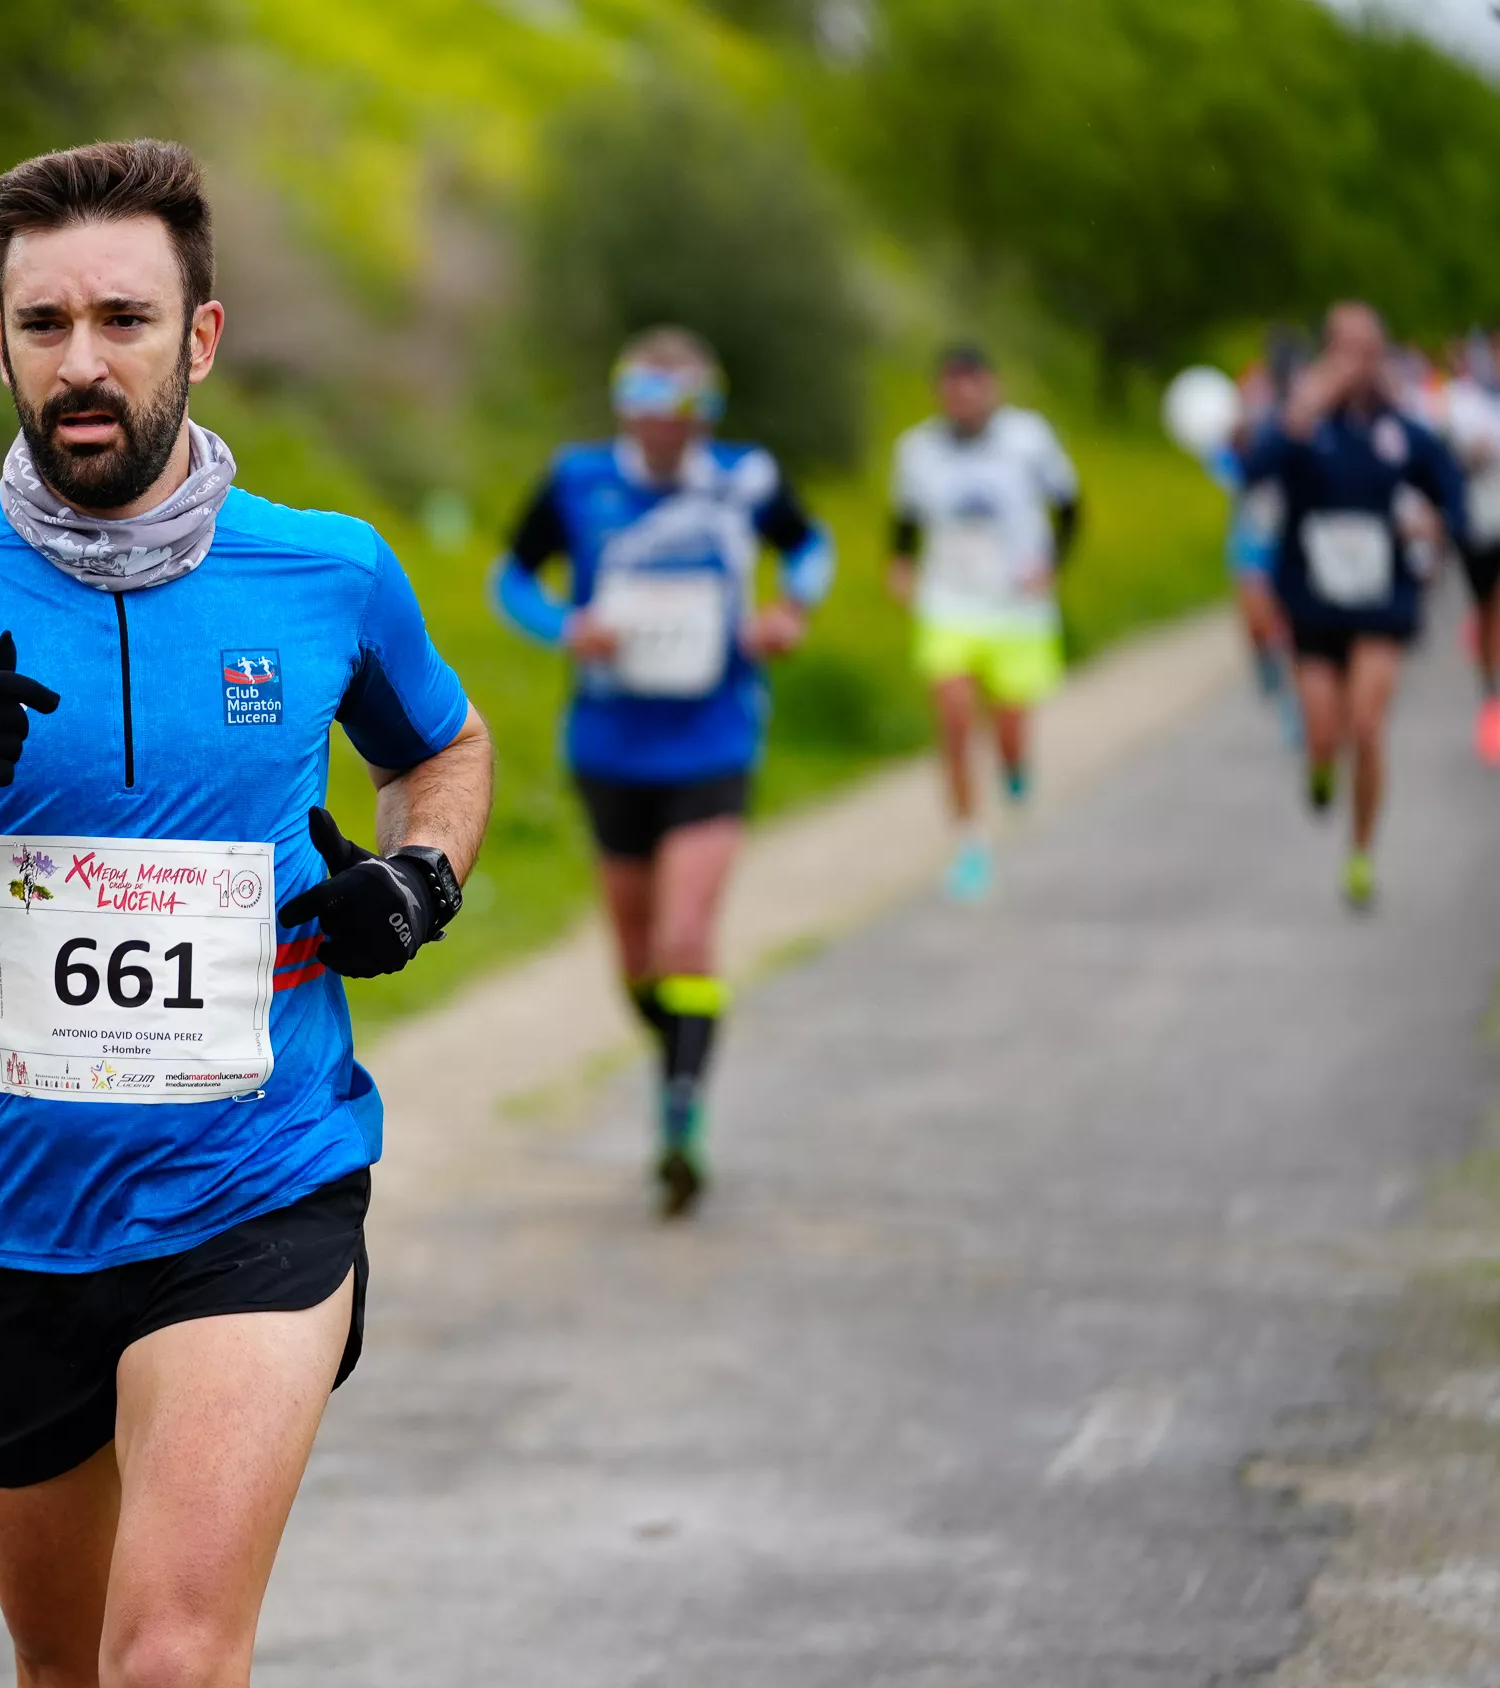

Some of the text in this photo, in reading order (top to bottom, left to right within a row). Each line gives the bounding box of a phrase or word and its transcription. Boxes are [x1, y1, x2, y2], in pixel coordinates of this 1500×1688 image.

[196, 474, 220, 495] Cars
[225, 686, 259, 698] Club
[227, 698, 282, 711] Maratón
[227, 712, 277, 723] Lucena
[97, 883, 189, 914] LUCENA
[389, 912, 412, 947] ipso
[54, 937, 204, 1009] 661
[52, 1028, 204, 1042] ANTONIO DAVID OSUNA PEREZ
[102, 1044, 151, 1055] S-Hombre
[165, 1071, 259, 1081] mediamaratonlucena.com
